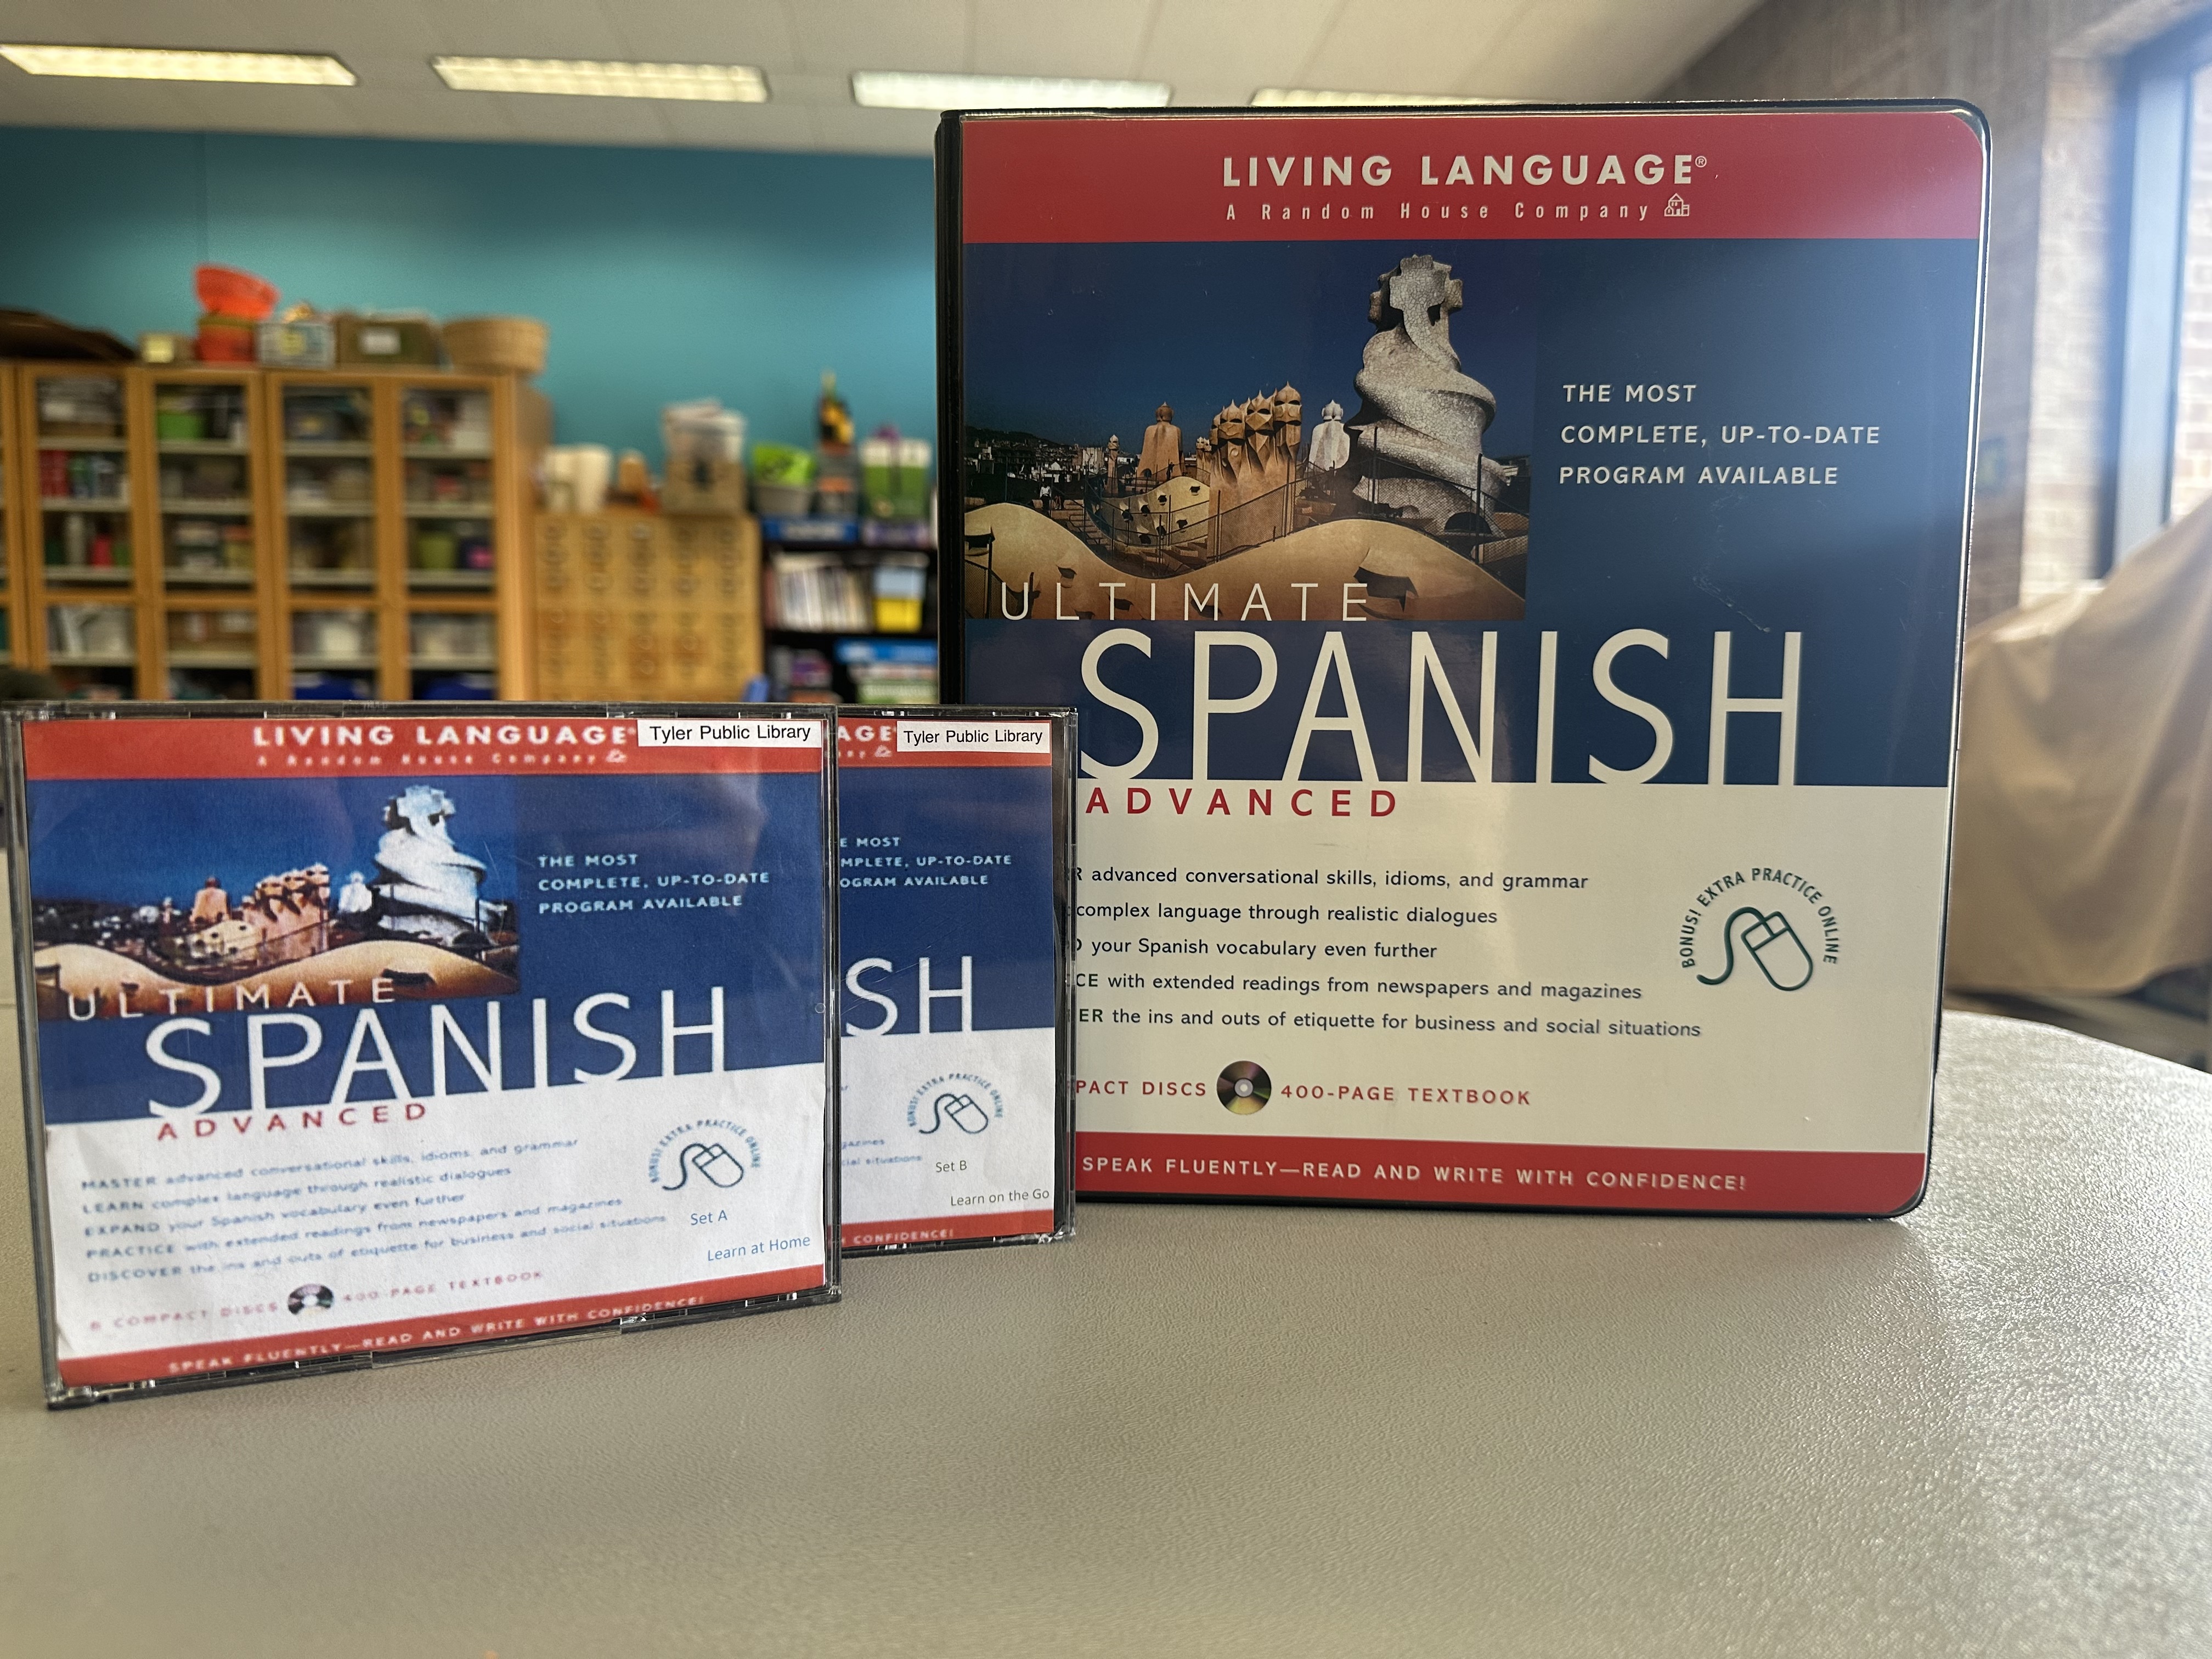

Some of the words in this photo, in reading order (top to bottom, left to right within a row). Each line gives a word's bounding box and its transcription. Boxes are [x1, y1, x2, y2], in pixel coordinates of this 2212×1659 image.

[1223, 156, 1392, 187] LIVING
[1226, 204, 1236, 219] A
[1262, 204, 1373, 219] Random
[1401, 203, 1488, 219] House
[1515, 202, 1648, 221] Company
[1563, 385, 1611, 402] THE
[1625, 385, 1696, 402] MOST
[1561, 426, 1706, 448] COMPLETE,
[1721, 426, 1880, 444] UP-TO-DATE
[1559, 466, 1684, 484] PROGRAM
[1698, 466, 1838, 484] AVAILABLE
[1000, 582, 1368, 622] ULTIMATE
[1080, 628, 1803, 786] SPANISH
[253, 725, 395, 746] LIVING
[417, 724, 635, 746] LANGUAGE
[650, 725, 692, 744] Tyler
[701, 725, 750, 740] Public
[758, 724, 811, 741] Library
[904, 730, 939, 746] Tyler
[946, 730, 989, 743] Public
[995, 729, 1043, 744] Library
[1085, 788, 1398, 817] ADVANCED
[856, 837, 900, 848] MOST
[537, 855, 574, 868] THE
[585, 854, 639, 867] MOST
[840, 856, 909, 868] MPLETE,
[917, 855, 1012, 867] UP-TO-DATE
[657, 872, 769, 887] UP-TO-DATE
[840, 877, 896, 888] OGRAM
[904, 875, 989, 886] AVAILABLE
[1092, 866, 1177, 882] advanced
[1186, 868, 1318, 884] conversational
[1327, 870, 1377, 887] skills,
[1385, 870, 1451, 889] idioms,
[1459, 872, 1493, 887] and
[1502, 873, 1588, 891] grammar
[539, 900, 634, 914] PROGRAM
[642, 895, 743, 910] AVAILABLE
[1076, 902, 1150, 921] complex
[1158, 903, 1241, 922] language
[1249, 905, 1319, 924] through
[1328, 906, 1399, 922] realistic
[1407, 907, 1498, 927] dialogues
[1679, 909, 1701, 968] BONUS!
[1696, 871, 1746, 907] EXTRA
[1752, 867, 1822, 904] PRACTICE
[1817, 906, 1839, 964] ONLINE
[1091, 941, 1131, 956] your
[1138, 938, 1209, 957] Spanish
[1217, 940, 1316, 960] vocabulary
[1324, 944, 1366, 957] even
[1374, 941, 1437, 958] further
[1108, 973, 1145, 988] with
[1153, 974, 1234, 990] extended
[1243, 975, 1320, 995] readings
[1327, 977, 1369, 992] from
[1377, 980, 1489, 998] newspapers
[1497, 981, 1532, 996] and
[1541, 983, 1642, 1002] magazines
[67, 978, 395, 1022] ULTIMATE
[1112, 1008, 1141, 1023] the
[1148, 1009, 1173, 1024] ins
[1181, 1010, 1214, 1025] and
[1221, 1012, 1260, 1026] outs
[1268, 1011, 1286, 1026] of
[1294, 1012, 1375, 1031] etiquette
[1382, 1014, 1408, 1029] for
[1415, 1014, 1496, 1031] business
[1503, 1017, 1538, 1032] and
[1546, 1018, 1600, 1035] social
[1608, 1020, 1701, 1037] situations
[145, 986, 724, 1117] SPANISH
[1076, 1080, 1128, 1095] PACT
[1142, 1081, 1206, 1097] DISCS
[1280, 1085, 1394, 1102] 400-PAGE
[1408, 1087, 1531, 1105] TEXTBOOK
[157, 1102, 427, 1142] ADVANCED
[935, 1161, 955, 1173] Set
[960, 1160, 967, 1171] B
[1082, 1156, 1153, 1173] SPEAK
[1374, 1165, 1420, 1180] AND
[1433, 1166, 1503, 1184] WRITE
[1516, 1167, 1573, 1186] WITH
[1586, 1170, 1746, 1190] CONFIDENCE!
[82, 1176, 157, 1190] MASTER
[83, 1201, 144, 1214] LEARN
[951, 1193, 985, 1206] Learn
[989, 1194, 1004, 1202] on
[1009, 1190, 1029, 1201] the
[1032, 1188, 1049, 1199] Go
[690, 1212, 713, 1226] Set
[718, 1210, 727, 1221] A
[84, 1223, 160, 1237] EXPAND
[87, 1244, 175, 1259] PRACTICE
[708, 1245, 746, 1261] Learn
[751, 1242, 765, 1254] at
[770, 1237, 811, 1251] Home
[88, 1266, 182, 1283] DISCOVER
[421, 1326, 460, 1340] AND
[534, 1312, 579, 1325] WITH
